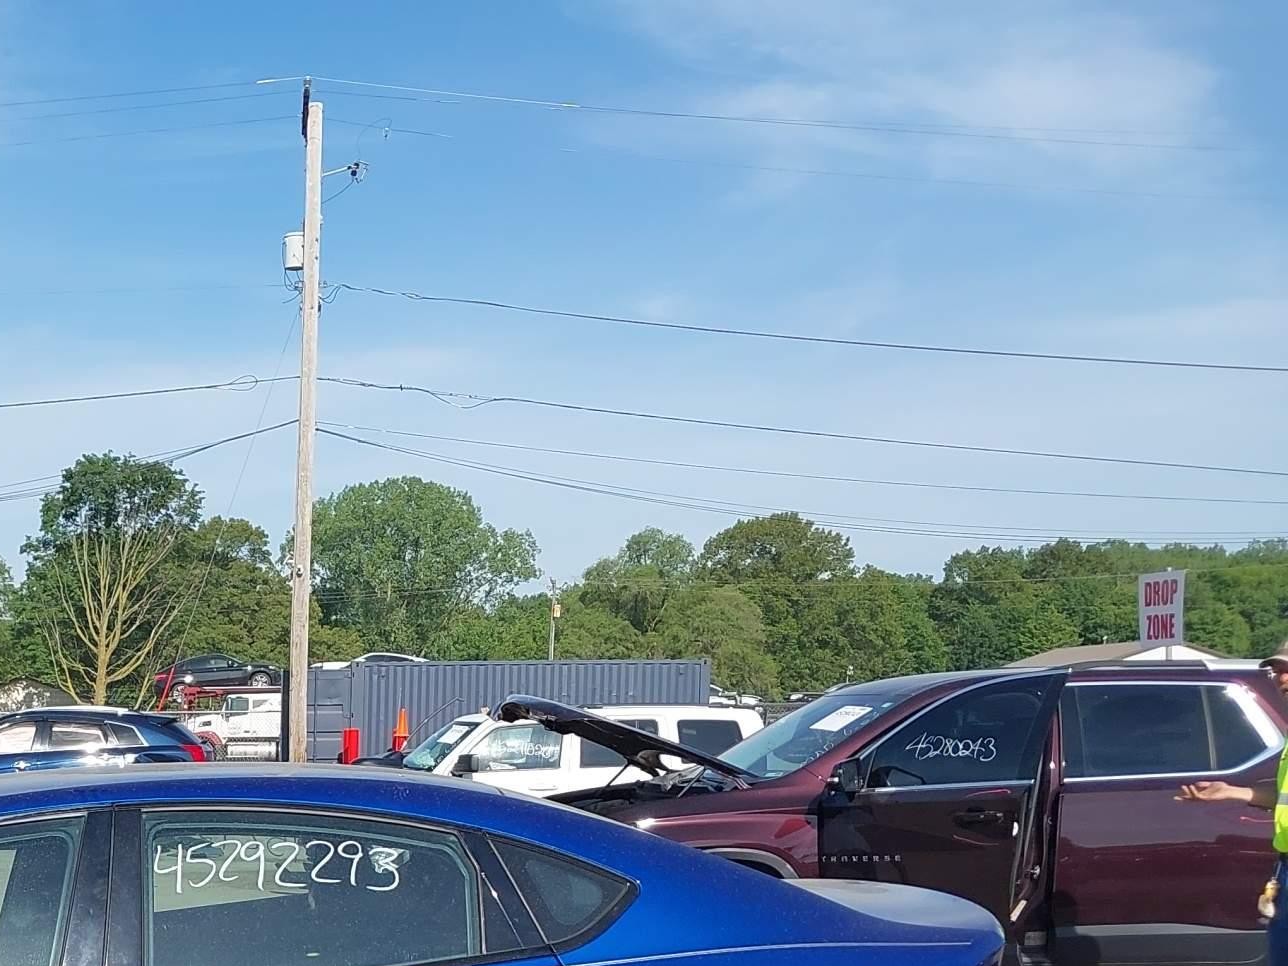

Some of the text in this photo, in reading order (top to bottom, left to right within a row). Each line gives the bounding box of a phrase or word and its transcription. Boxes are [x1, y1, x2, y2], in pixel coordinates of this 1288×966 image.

[1144, 579, 1178, 607] DROP
[1146, 613, 1176, 640] ZONE
[153, 839, 400, 894] 45292293
